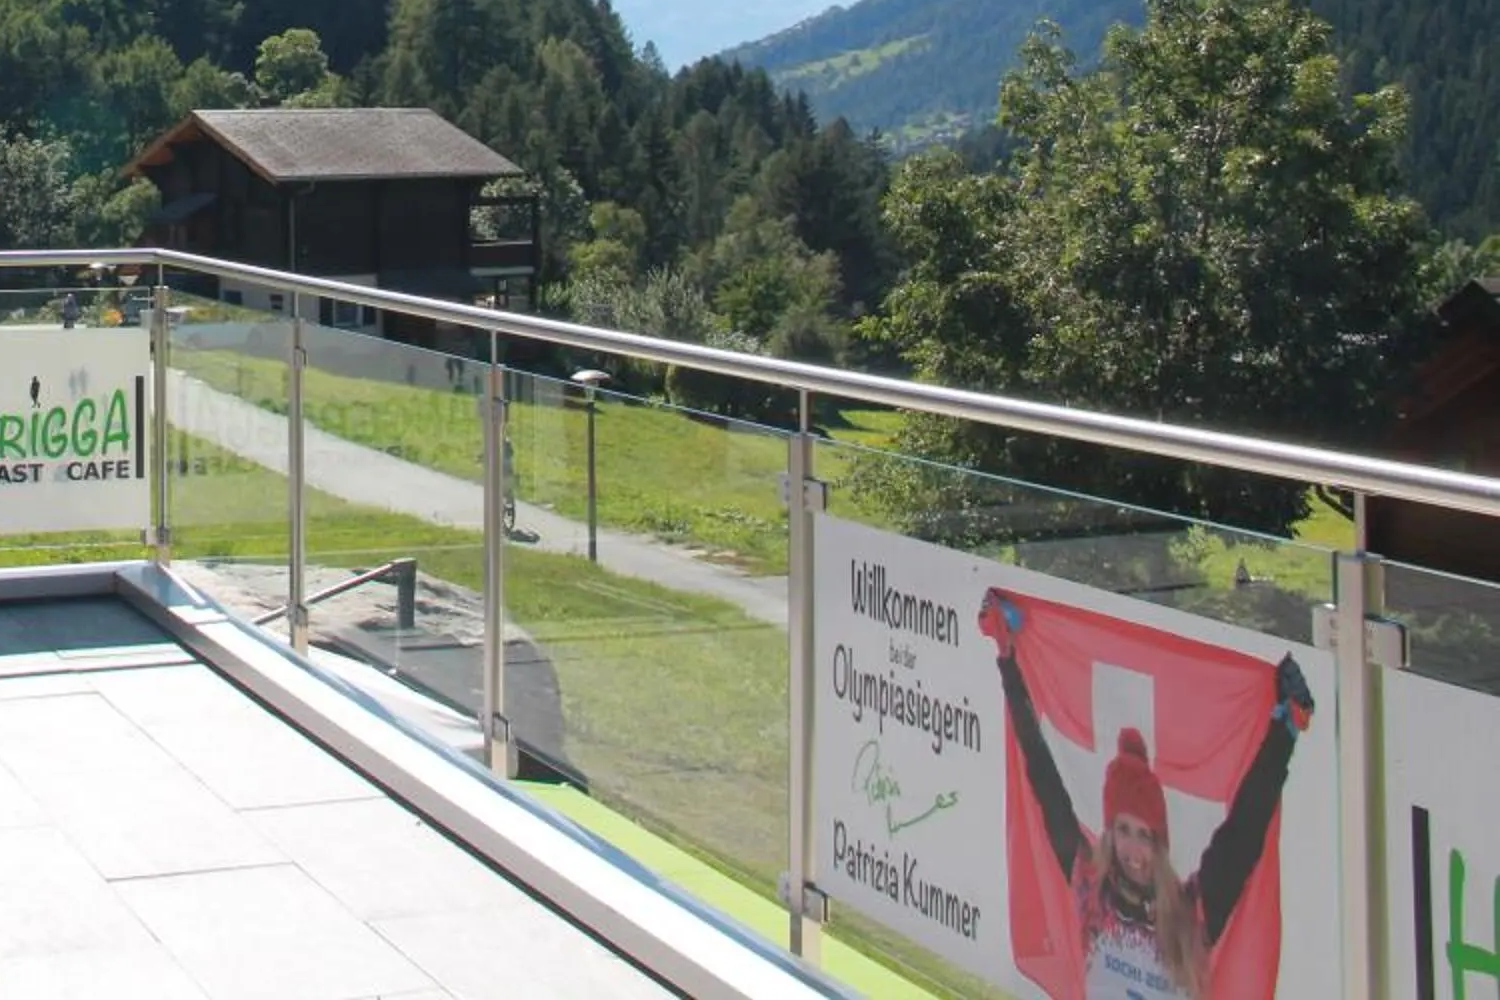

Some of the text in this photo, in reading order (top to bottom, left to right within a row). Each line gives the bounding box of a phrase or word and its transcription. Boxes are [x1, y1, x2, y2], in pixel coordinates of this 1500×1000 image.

[66, 459, 130, 481] CAFE
[851, 559, 959, 648] Willkommen
[833, 644, 981, 755] Olympiasiegerin
[833, 818, 981, 940] Patrizia Kummer
